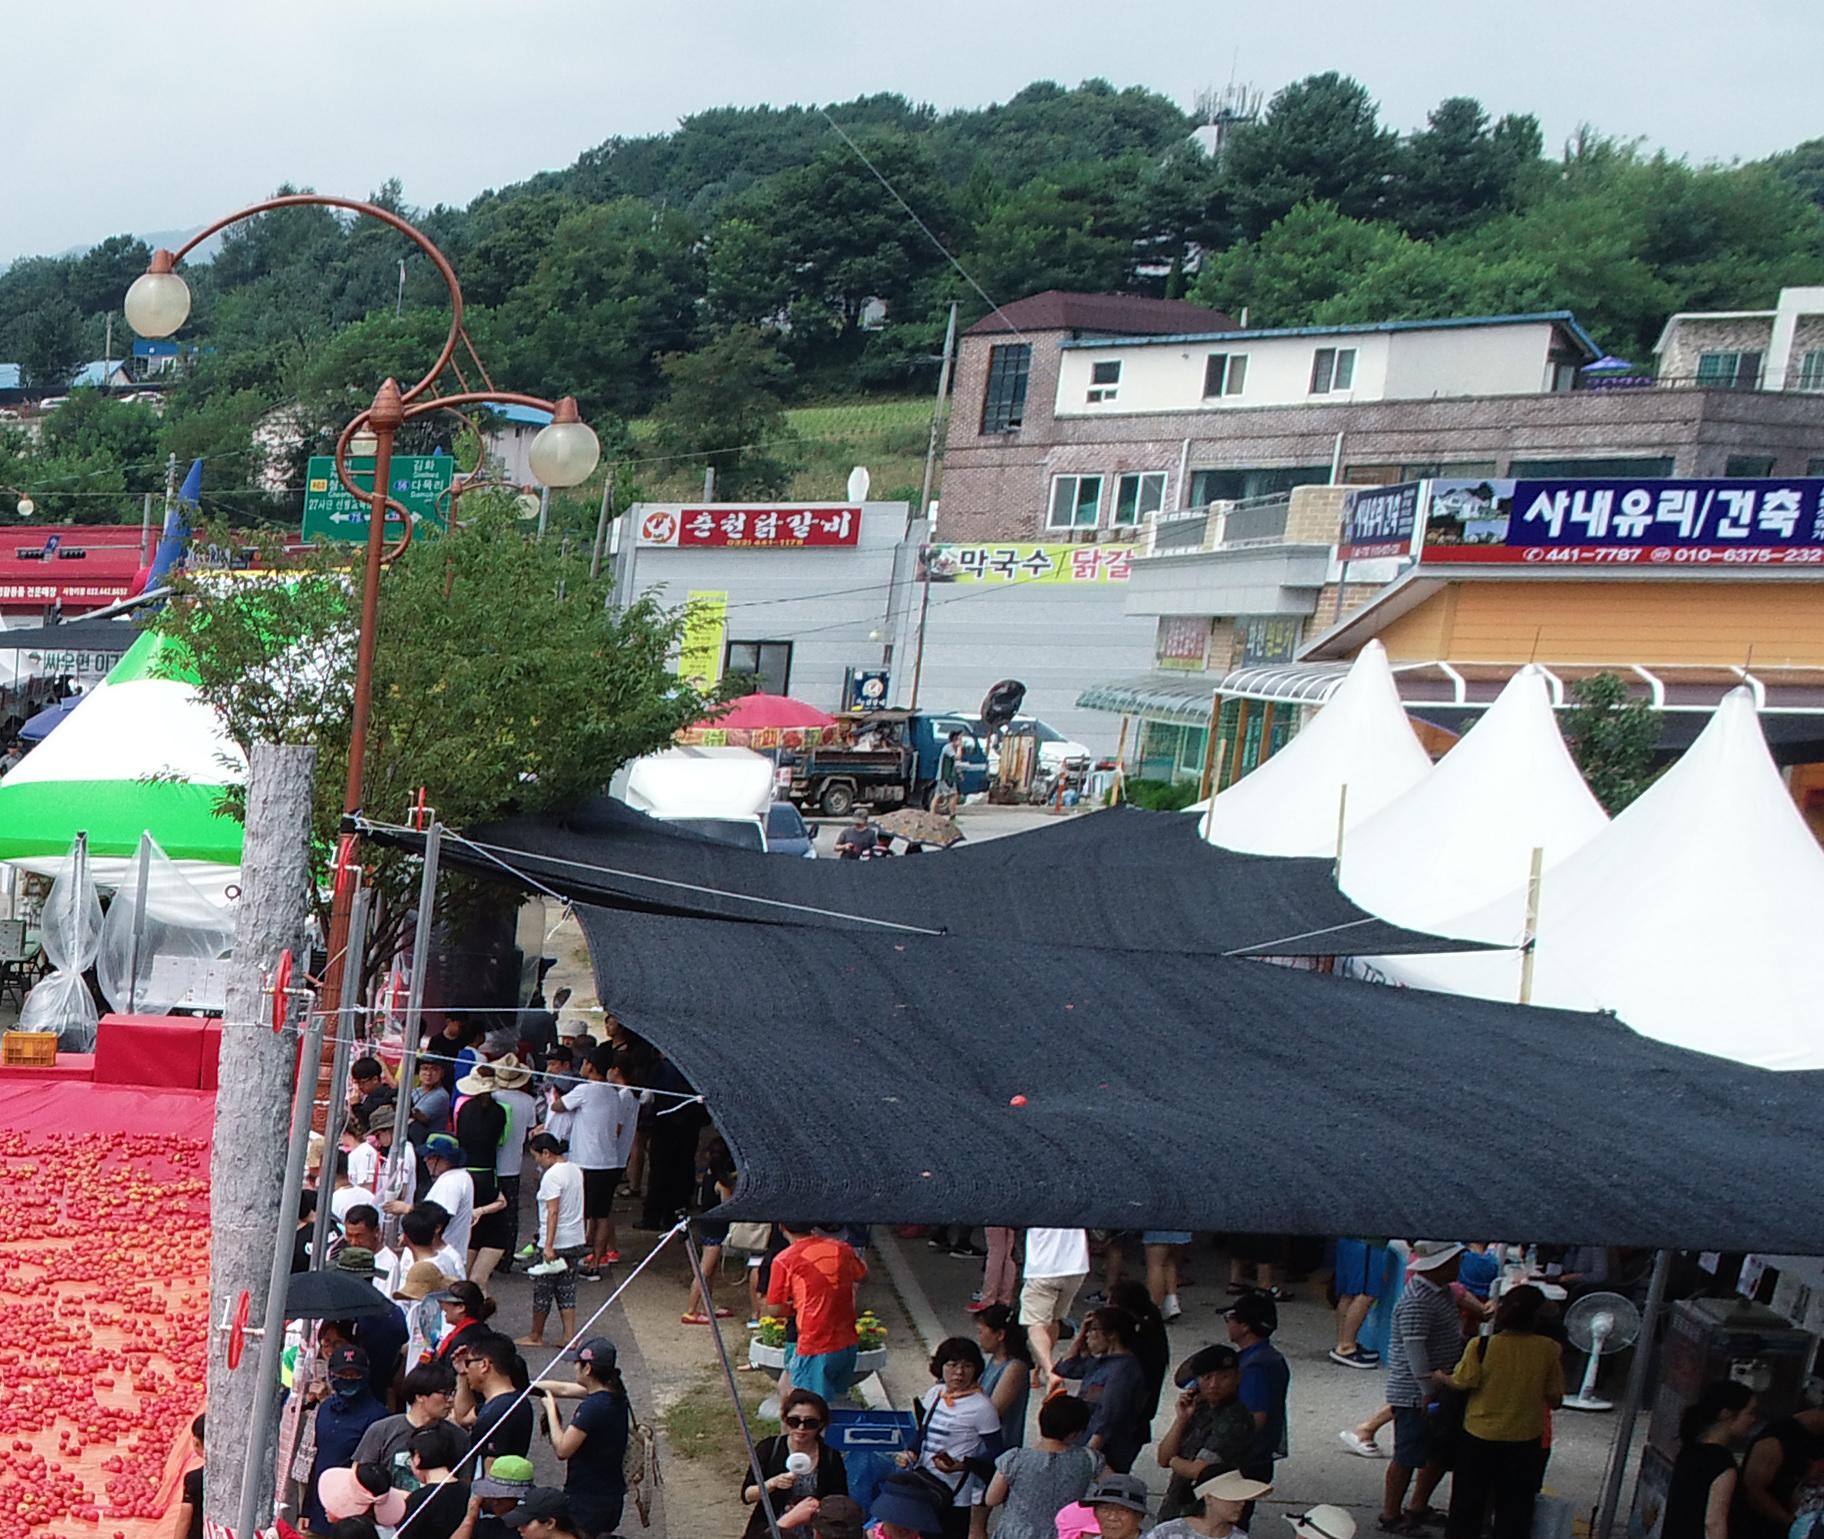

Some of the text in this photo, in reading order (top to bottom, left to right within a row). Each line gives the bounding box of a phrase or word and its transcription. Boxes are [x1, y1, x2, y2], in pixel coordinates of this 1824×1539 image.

[686, 510, 852, 540] 춘천닭갈비
[1523, 486, 1803, 539] 사내유리/건축
[959, 549, 1052, 579] 막국수
[1546, 547, 1640, 562] 441-7787
[45, 653, 90, 672] 싸우면
